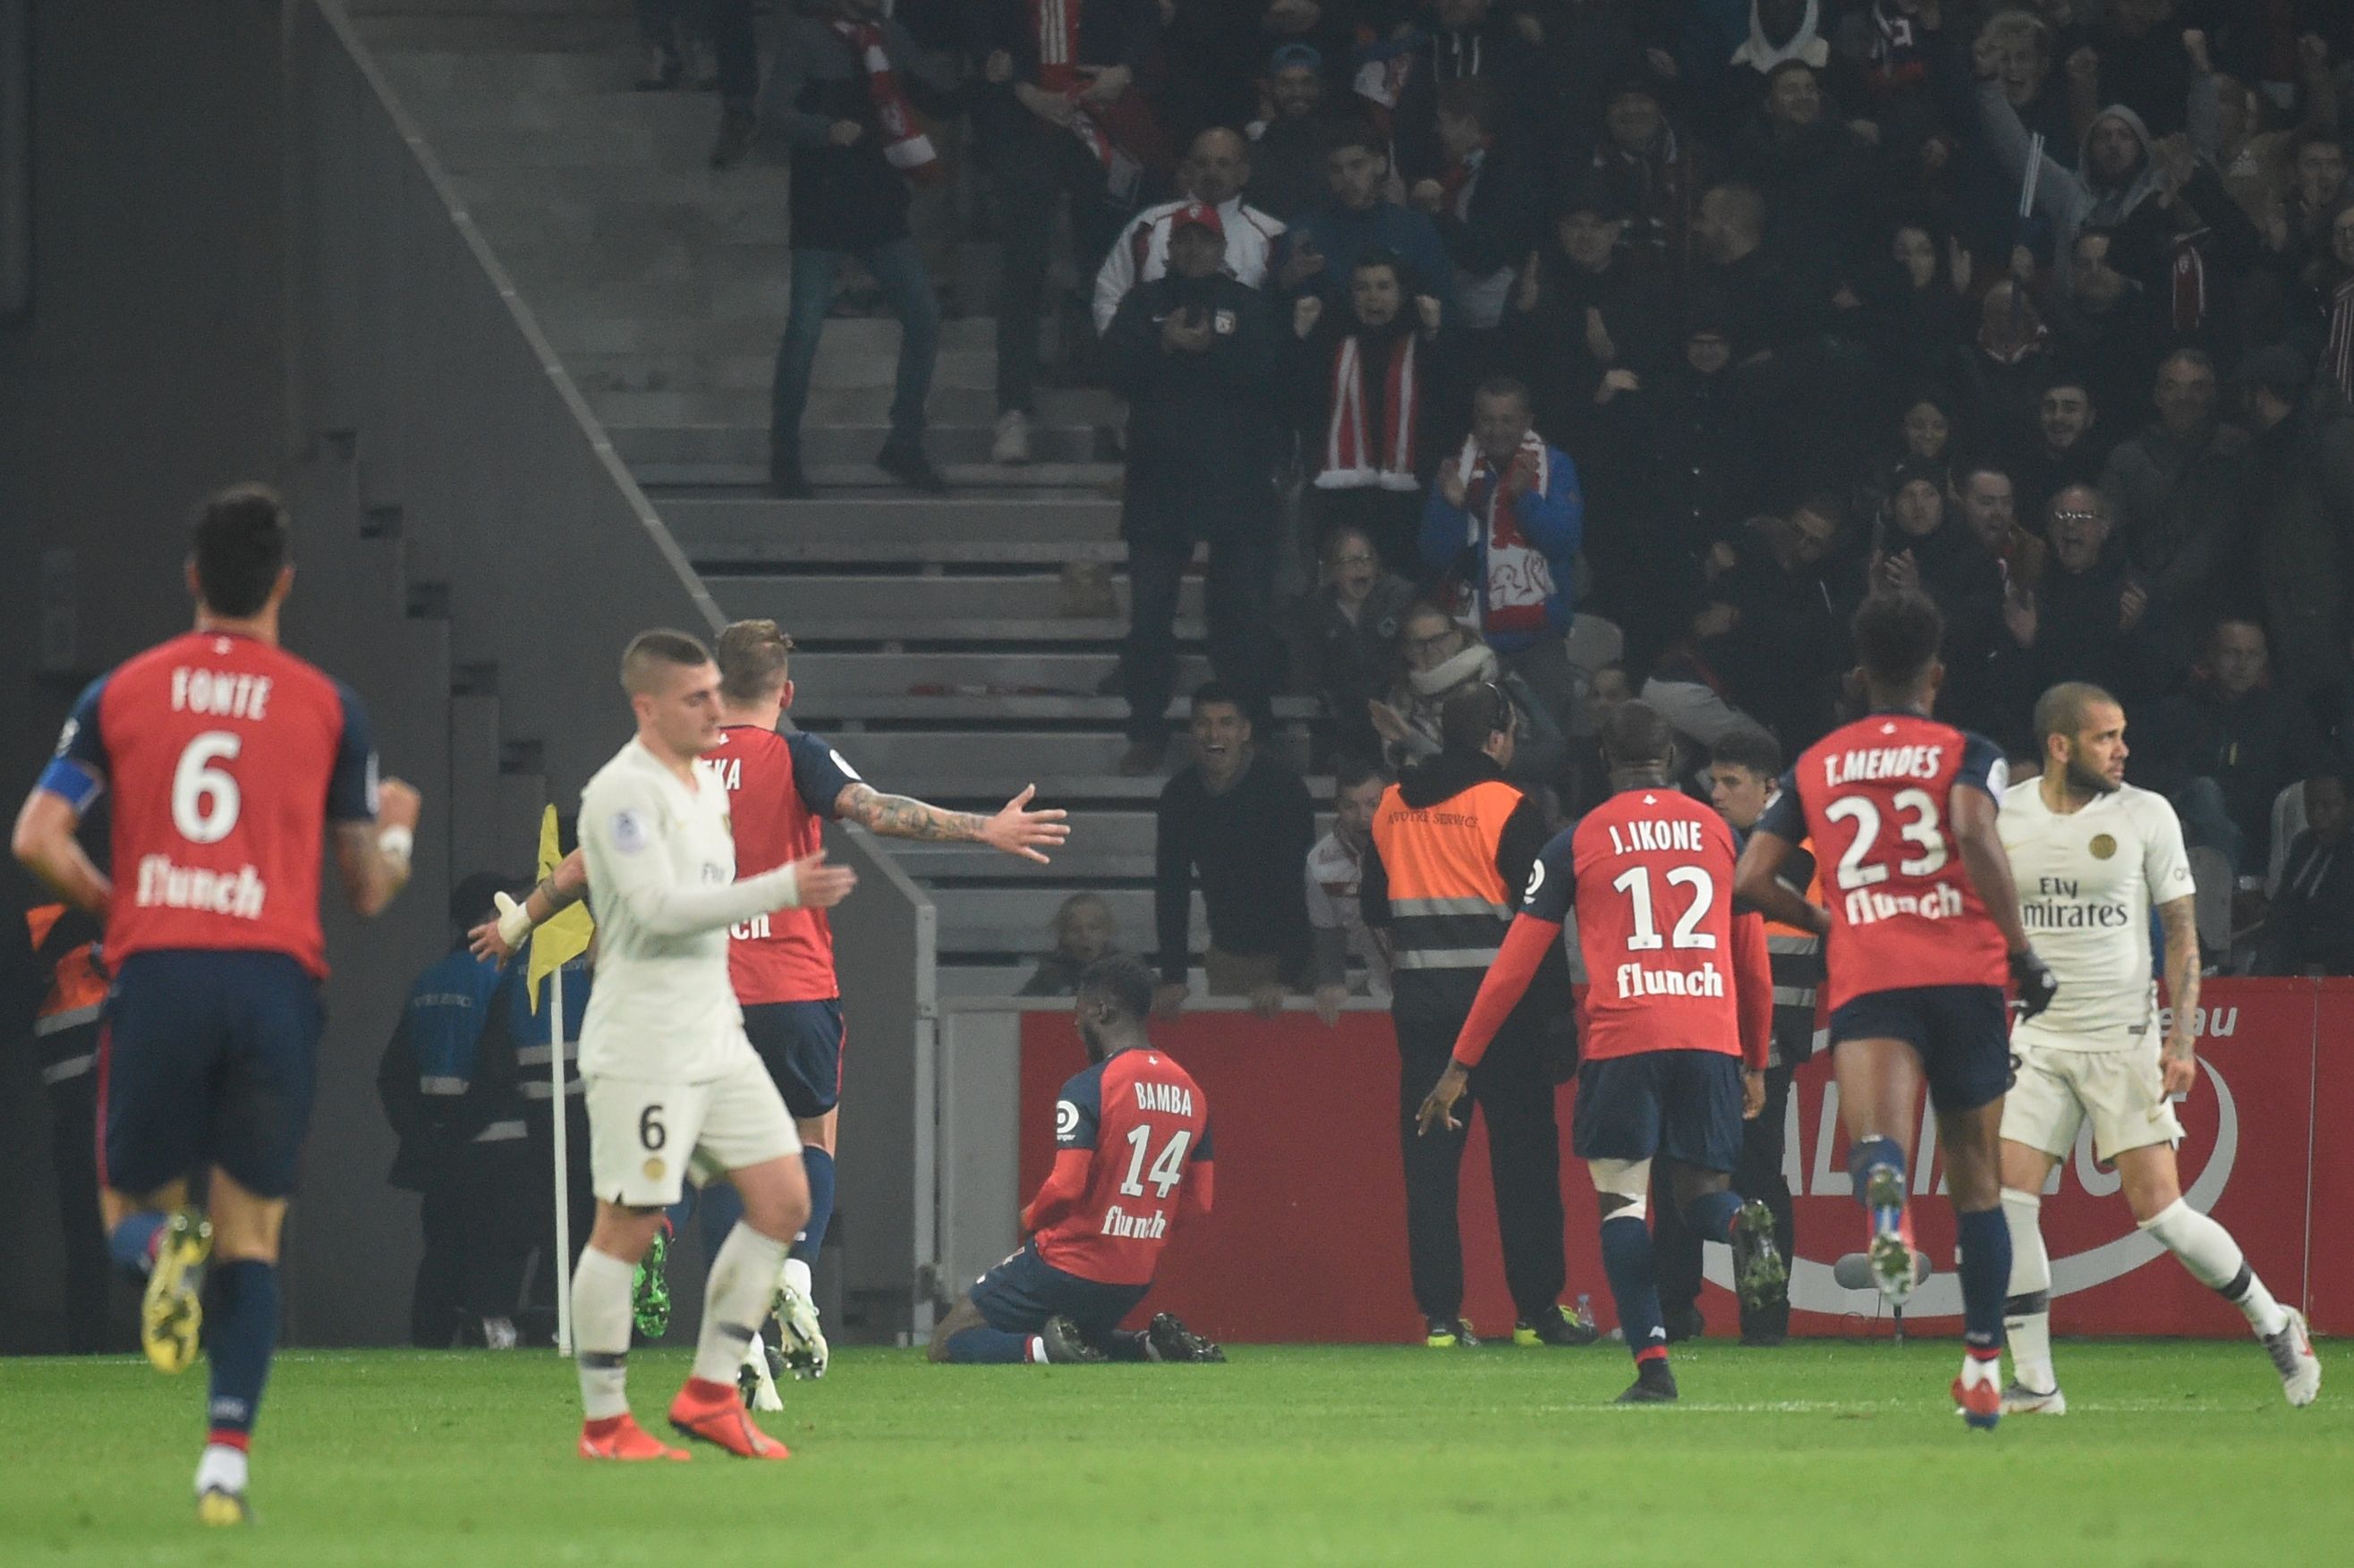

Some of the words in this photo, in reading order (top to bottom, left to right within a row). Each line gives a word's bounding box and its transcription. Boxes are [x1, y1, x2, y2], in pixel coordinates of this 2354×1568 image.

[172, 665, 273, 720] FONTE
[171, 729, 242, 844] 6
[1823, 744, 1943, 787] T.MENDES
[1609, 819, 1704, 855] J.IKONE
[1824, 787, 1949, 890] 23
[1612, 865, 1717, 952] 12
[2038, 877, 2078, 900] Fly
[2022, 898, 2129, 928] mirates
[1617, 962, 1724, 999] flunch
[1134, 1081, 1192, 1117] BAMBA
[639, 1104, 667, 1152] 6
[1120, 1124, 1192, 1199] 14
